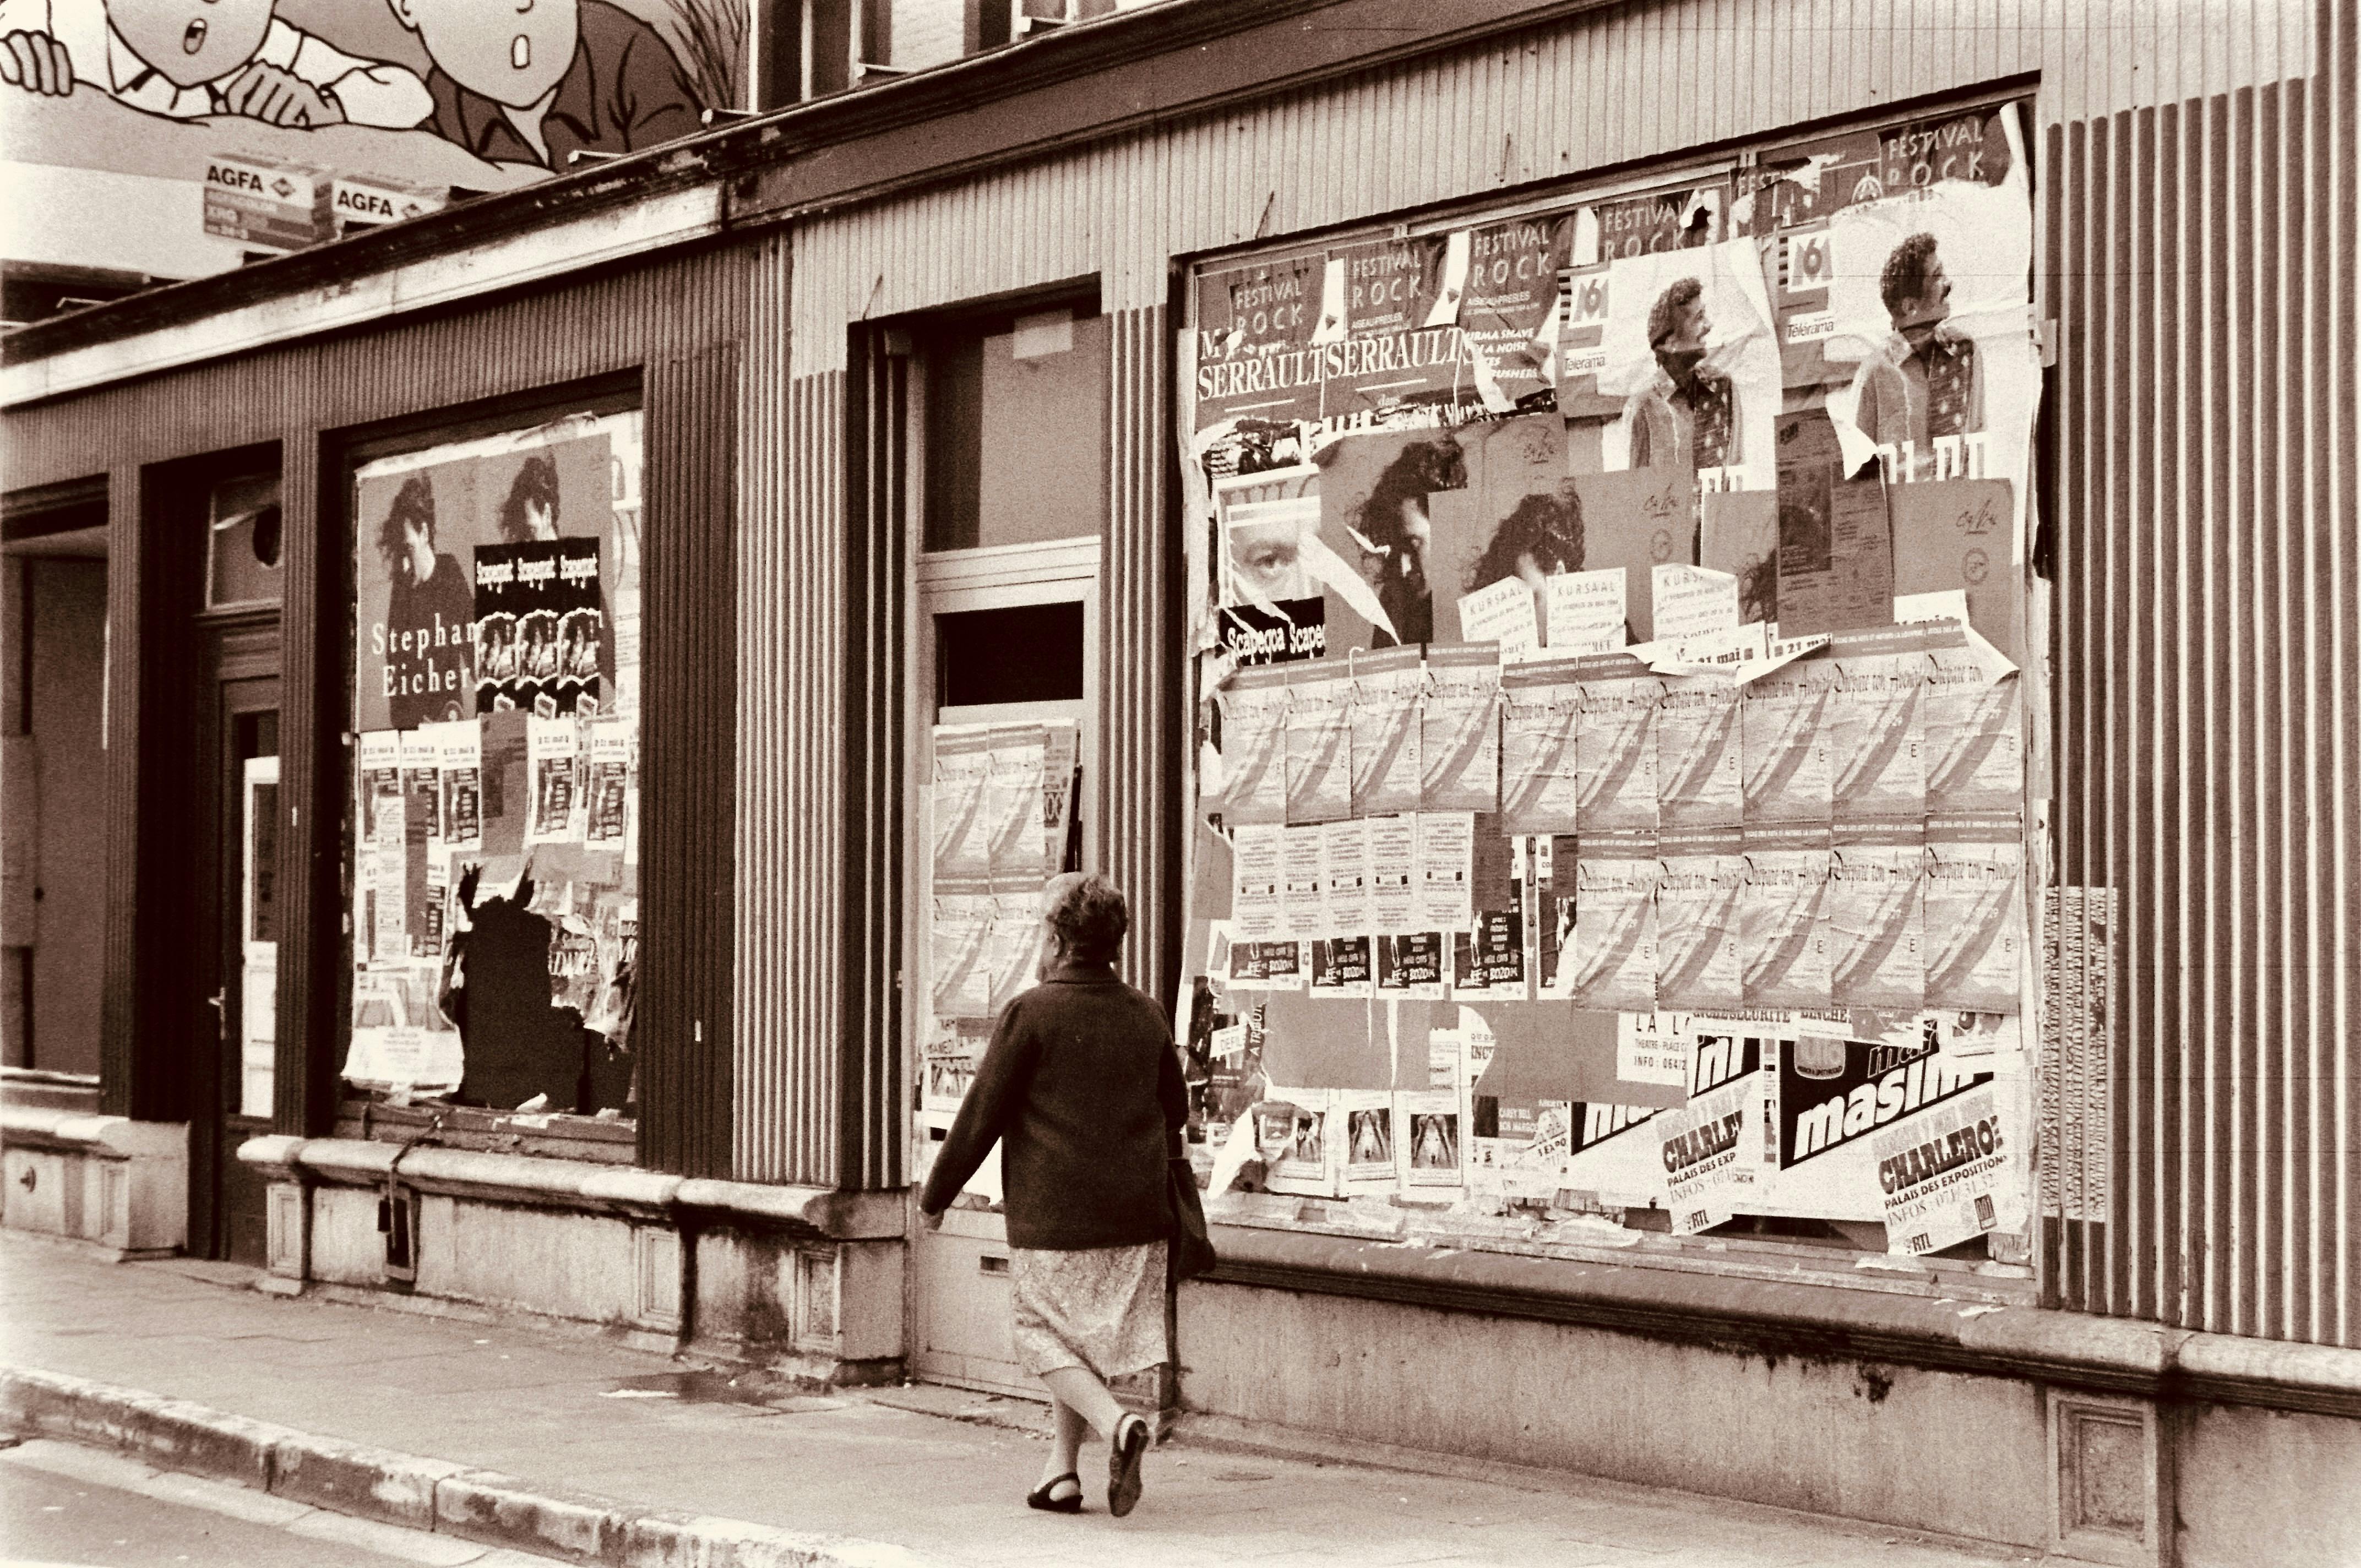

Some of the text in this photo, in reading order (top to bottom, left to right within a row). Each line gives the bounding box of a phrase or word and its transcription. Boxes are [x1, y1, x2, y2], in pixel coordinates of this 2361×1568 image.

[1889, 119, 1983, 161] FESTIVAL
[206, 165, 264, 193] AGFA
[337, 189, 393, 217] AGFA
[1474, 224, 1549, 257] FESTIVAL
[1352, 249, 1422, 279] FESTIVAL
[1472, 252, 1551, 287] ROCK
[1235, 277, 1302, 309] FESTIVAL
[1352, 275, 1424, 309] ROCK
[1343, 326, 1464, 382] SERRAULT
[1197, 347, 1323, 401] SERRAULT
[372, 612, 478, 660] Stephan
[383, 657, 471, 696] Eicher
[1662, 1109, 1743, 1173] CHARLE
[1667, 1167, 1698, 1188] PALAIS
[1700, 1159, 1716, 1174] DES
[1884, 1189, 1919, 1210] PALAIS
[1921, 1180, 1940, 1195] DES
[1691, 1209, 1709, 1228] RTL
[1911, 1232, 1933, 1253] RTL
